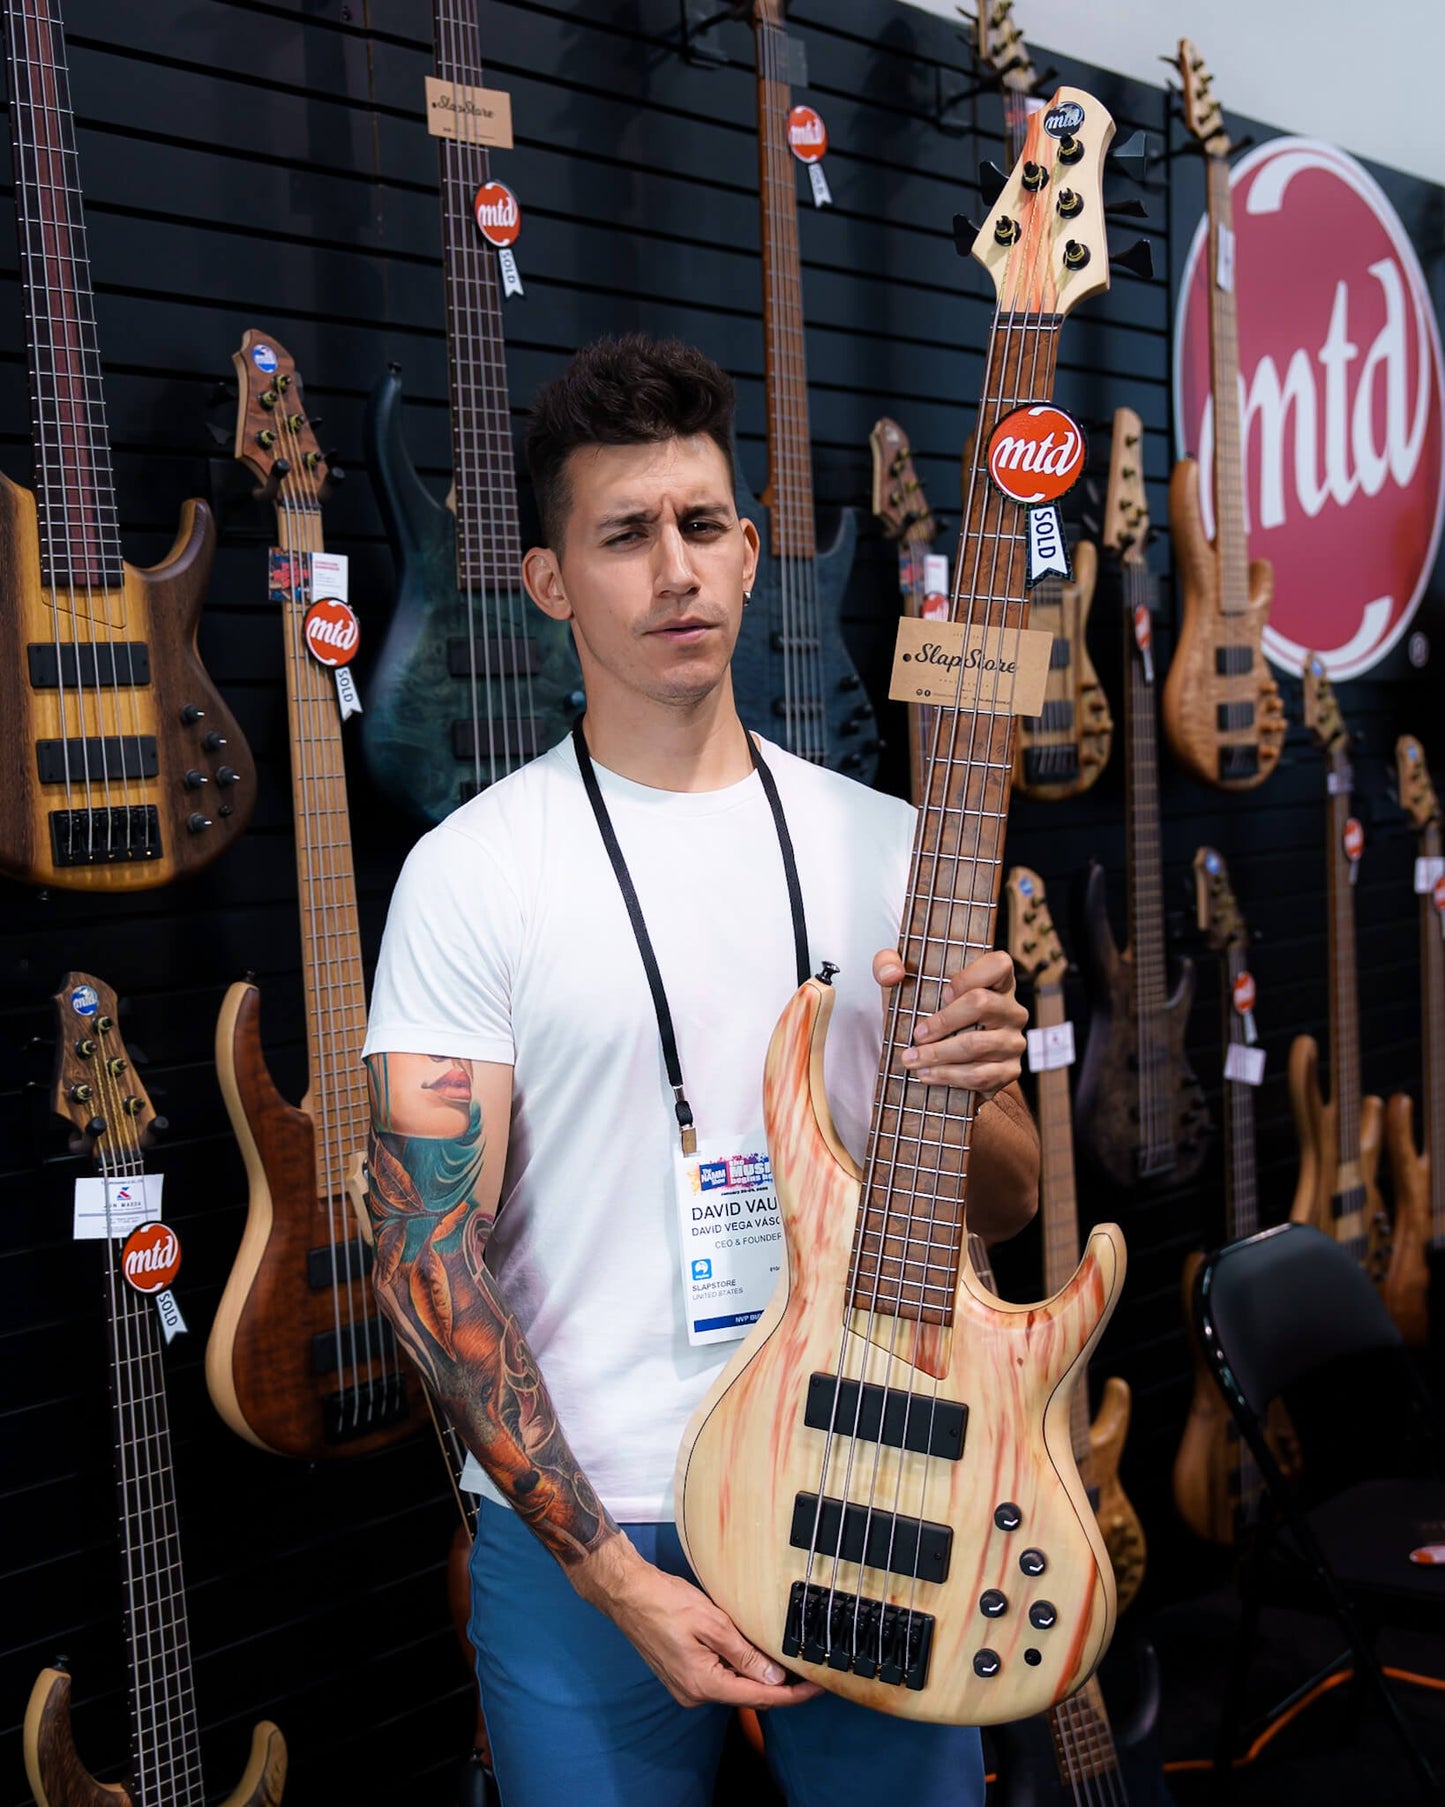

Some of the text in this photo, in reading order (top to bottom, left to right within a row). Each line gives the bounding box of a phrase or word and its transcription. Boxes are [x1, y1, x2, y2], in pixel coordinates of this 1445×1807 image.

[477, 197, 518, 227] mtd
[501, 252, 516, 284] SOLD
[1200, 257, 1431, 541] mtd
[992, 431, 1080, 477] mtd
[1034, 511, 1057, 560] SOLD
[307, 616, 358, 651] mtd
[914, 642, 1018, 674] SlapStore
[338, 670, 354, 703] SOLD
[701, 1168, 726, 1183] NAMM
[691, 1202, 741, 1221] DAVID
[691, 1224, 722, 1236] DAVID
[724, 1220, 753, 1232] VEGA
[715, 1239, 733, 1249] CEO
[735, 1238, 741, 1246] &
[125, 1235, 178, 1275] mtd
[692, 1279, 736, 1292] SLAPSTORE
[692, 1287, 744, 1301] UNITED STATES
[159, 1293, 178, 1327] SOLD
